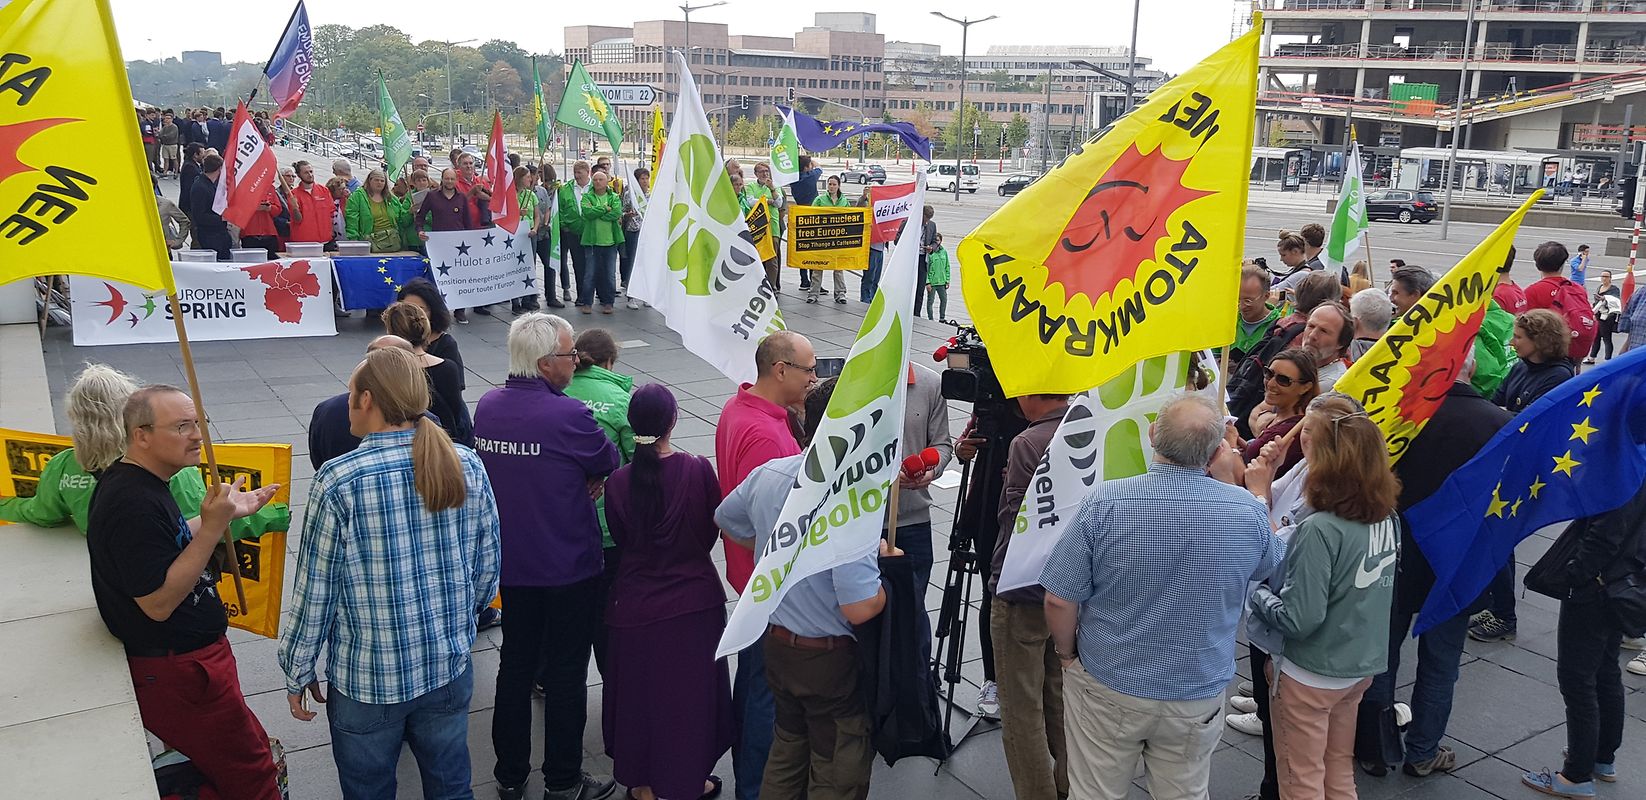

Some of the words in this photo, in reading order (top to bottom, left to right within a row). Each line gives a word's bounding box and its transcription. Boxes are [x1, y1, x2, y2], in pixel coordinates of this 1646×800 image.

[602, 89, 621, 100] NOM
[639, 89, 649, 100] 22
[876, 204, 891, 217] déi
[798, 215, 820, 225] Build
[829, 214, 861, 224] nuclear
[798, 229, 815, 238] free
[817, 227, 848, 237] Europe.
[454, 257, 483, 267] Hulot
[485, 257, 491, 265] a
[493, 251, 516, 264] raison
[468, 272, 506, 285] énergétique
[505, 265, 532, 278] immédiate
[458, 287, 475, 296] pour
[476, 284, 494, 294] toute
[494, 279, 516, 291] l'Europe
[165, 288, 246, 301] UROPEAN
[165, 301, 247, 320] SPRING
[584, 400, 614, 414] ACE
